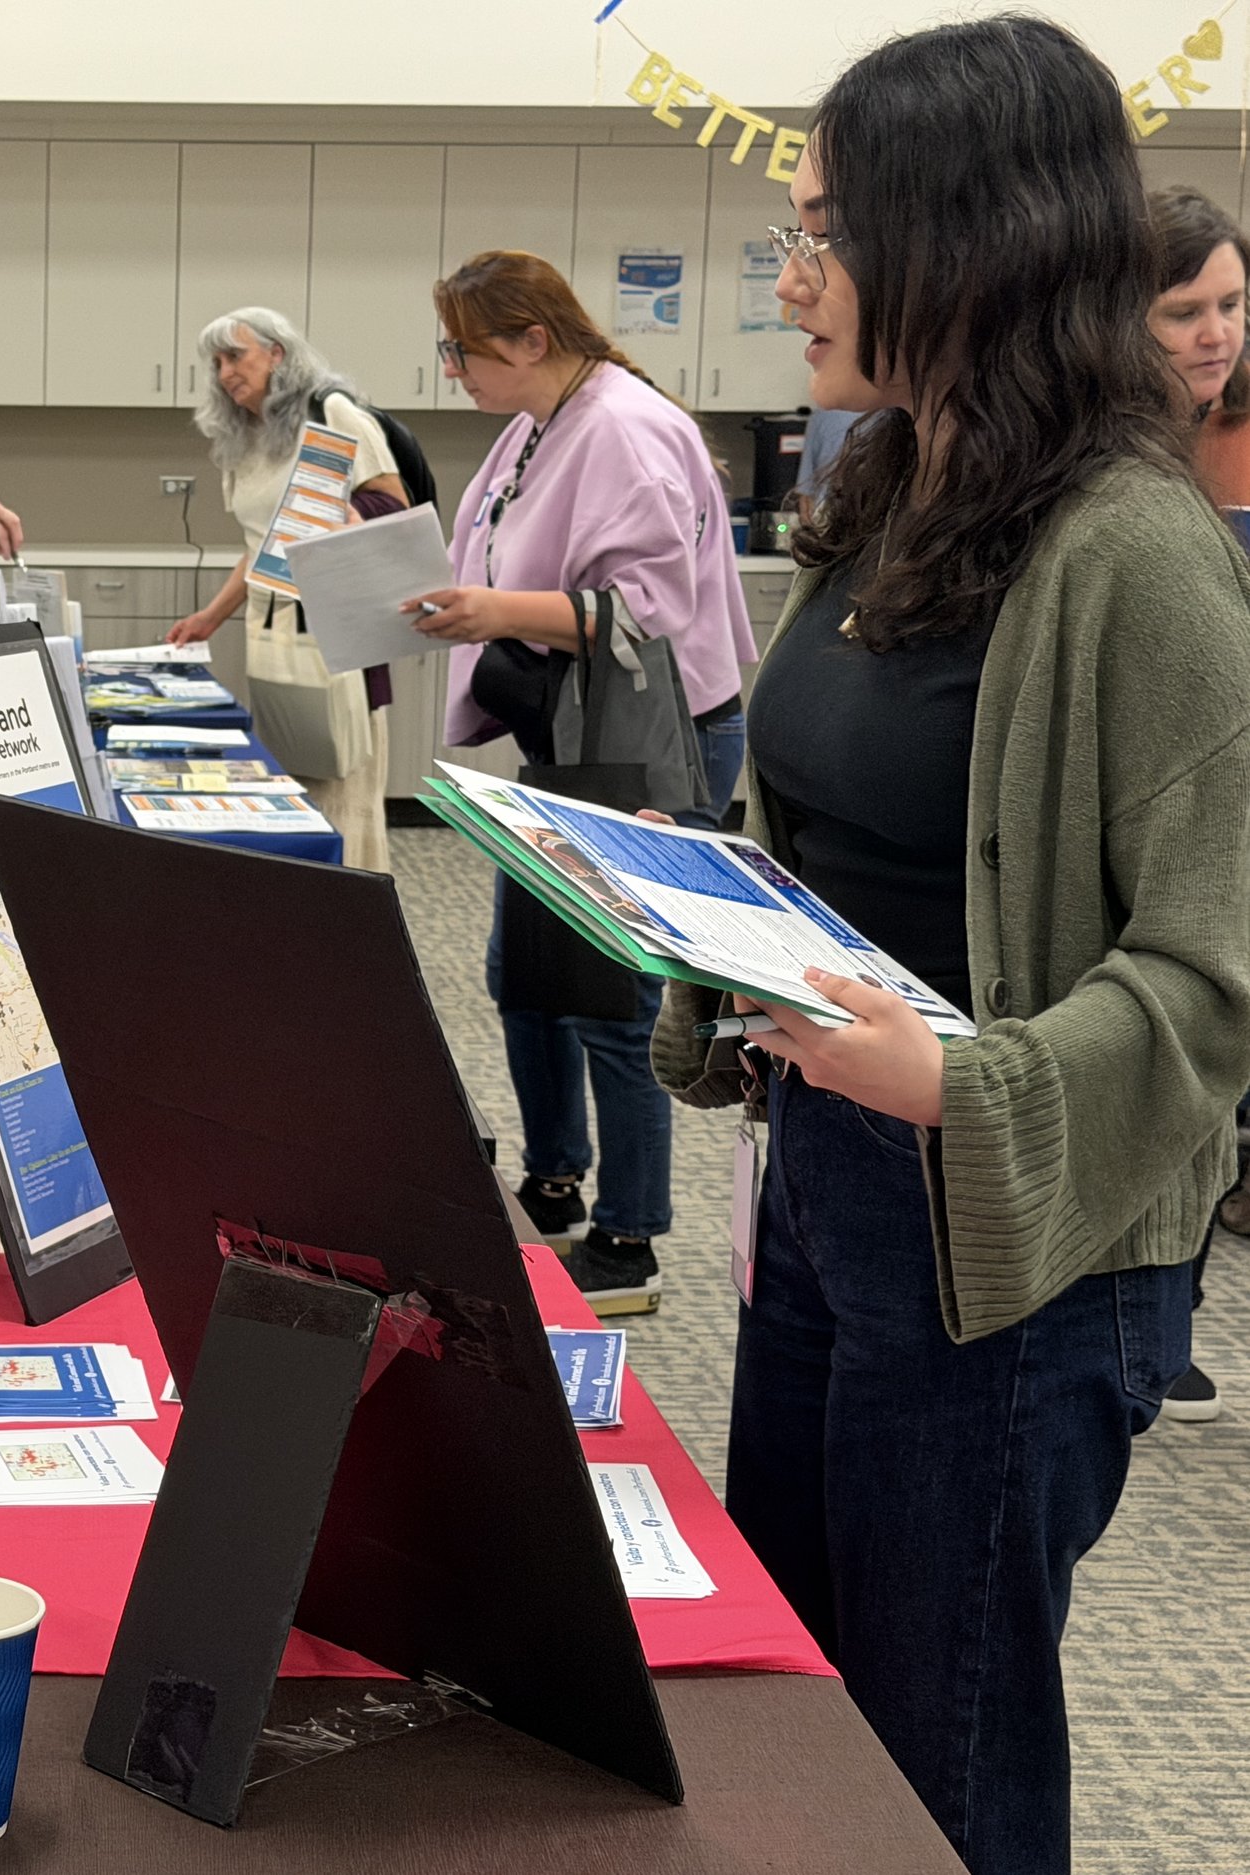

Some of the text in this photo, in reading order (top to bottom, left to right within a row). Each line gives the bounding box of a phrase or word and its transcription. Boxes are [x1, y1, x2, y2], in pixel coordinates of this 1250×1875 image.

[21, 764, 38, 774] Portland
[38, 762, 50, 770] metro
[571, 1355, 586, 1366] with
[565, 1366, 583, 1385] Connect
[564, 1385, 580, 1396] and
[598, 1472, 617, 1498] nosotros
[609, 1498, 622, 1510] con
[612, 1511, 635, 1541] conéctate
[626, 1547, 644, 1566] Visita
